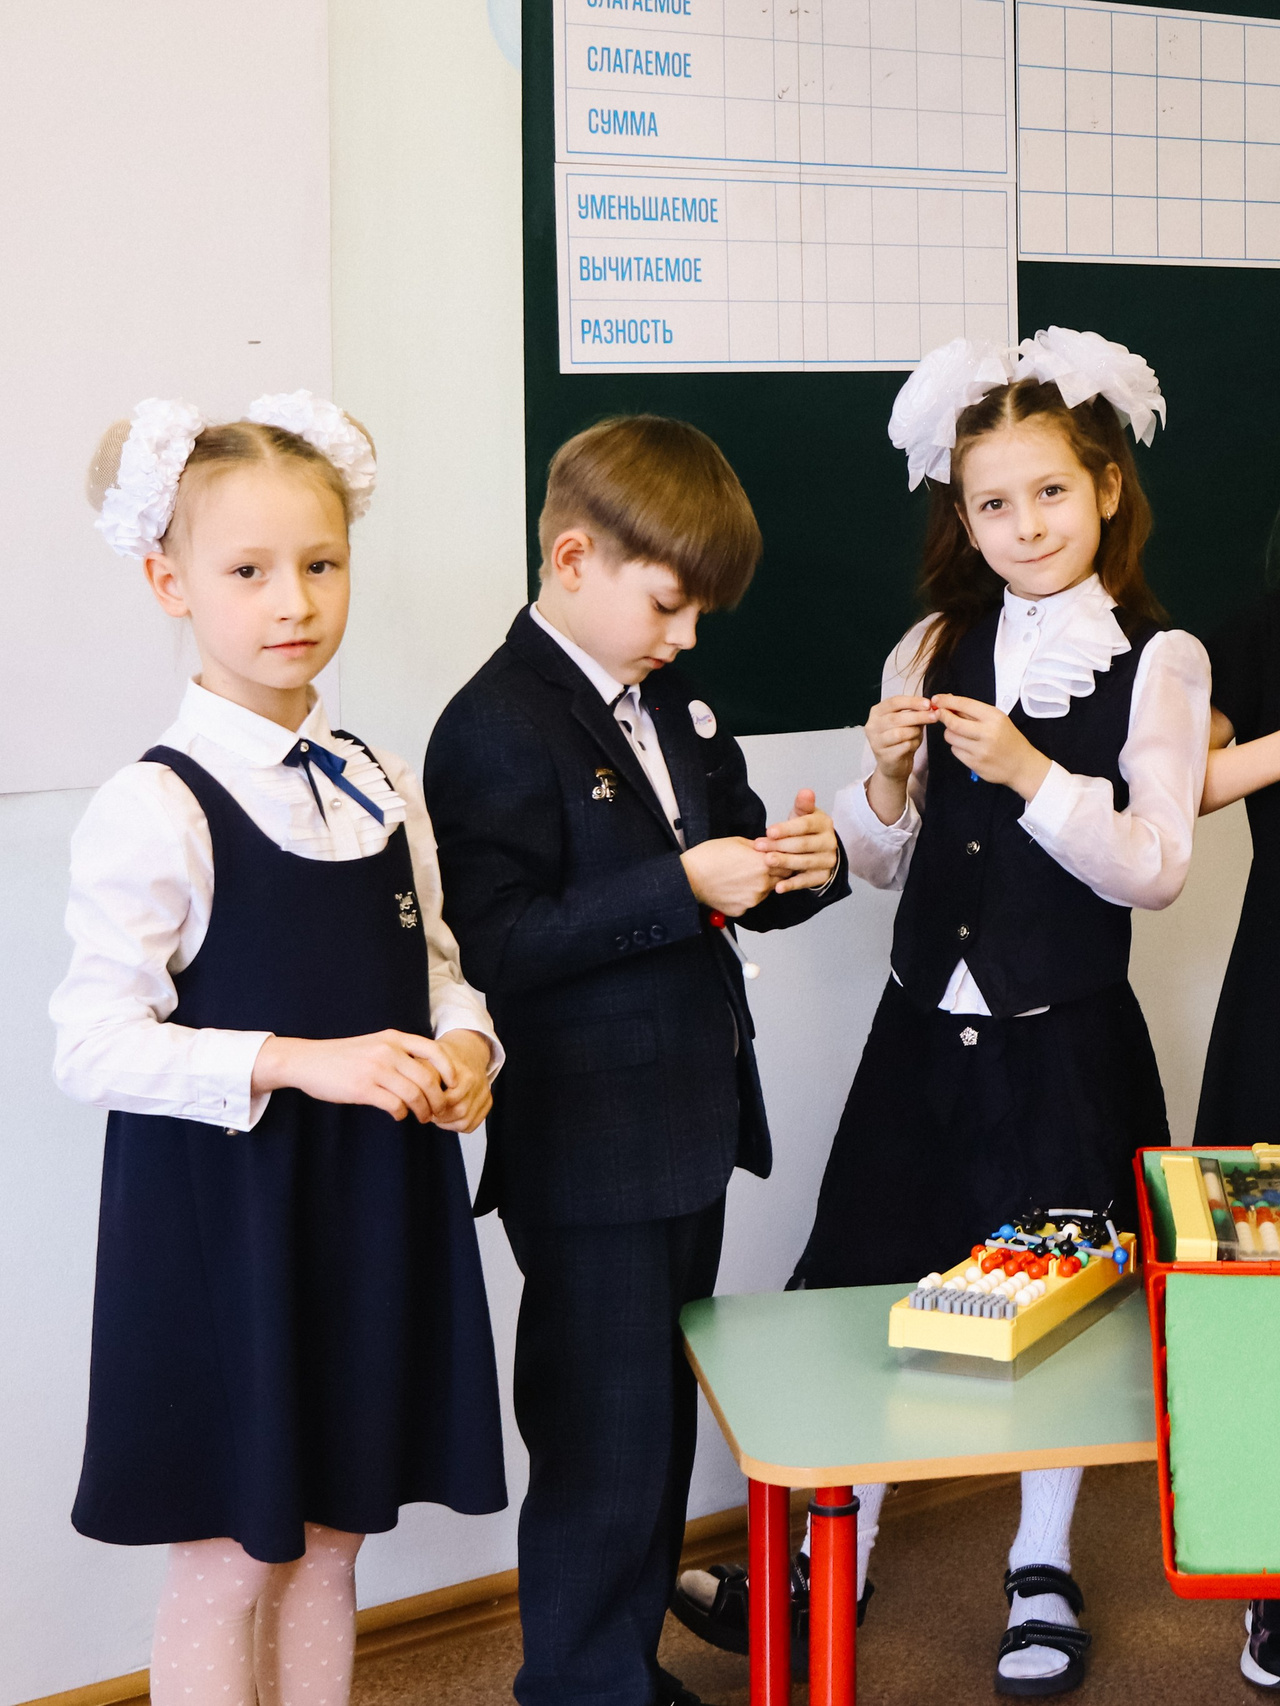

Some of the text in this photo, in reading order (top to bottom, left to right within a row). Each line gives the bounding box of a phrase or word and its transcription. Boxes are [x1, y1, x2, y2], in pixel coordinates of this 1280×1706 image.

[587, 46, 692, 78] СЛАГАЕМОЕ
[588, 108, 658, 137] СУММА
[577, 194, 719, 223] УМЕНЬШАЕМОЕ
[579, 256, 702, 282] ВЫЧИТАЕМОЕ
[581, 319, 673, 344] РАЗНОСТЬ
